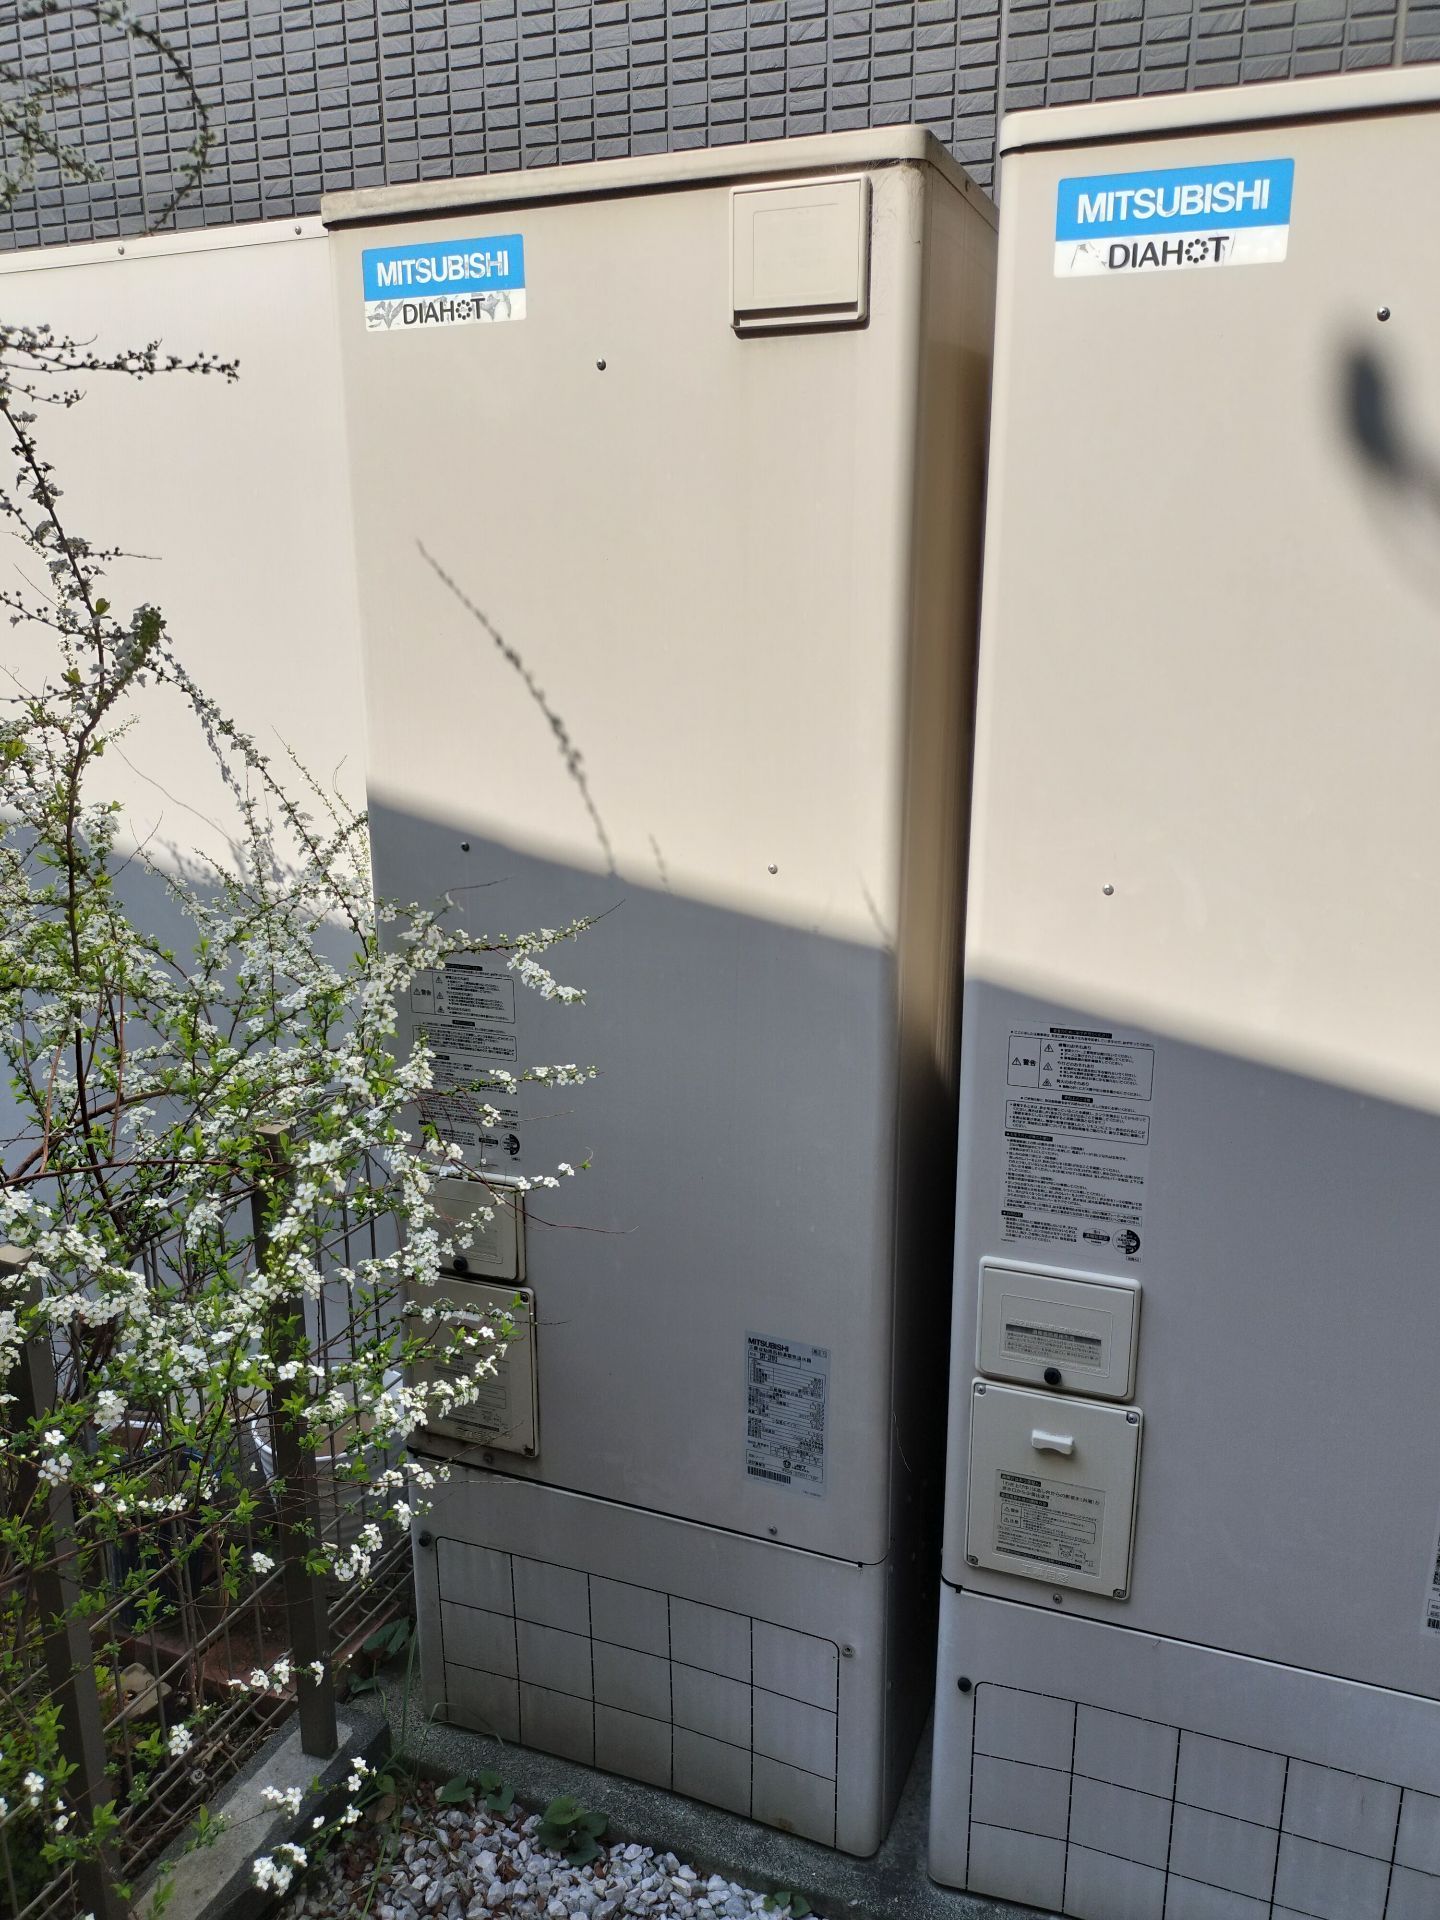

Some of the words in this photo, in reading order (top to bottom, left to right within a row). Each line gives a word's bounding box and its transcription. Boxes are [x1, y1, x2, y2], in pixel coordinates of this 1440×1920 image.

[1077, 179, 1270, 224] MITSUBISHI
[1108, 236, 1230, 269] DIAHOT
[377, 250, 508, 287] MITSUBISHI
[402, 298, 485, 324] DIAHOT
[1023, 1058, 1037, 1067] 警告
[748, 1337, 789, 1352] MITSUBISHI
